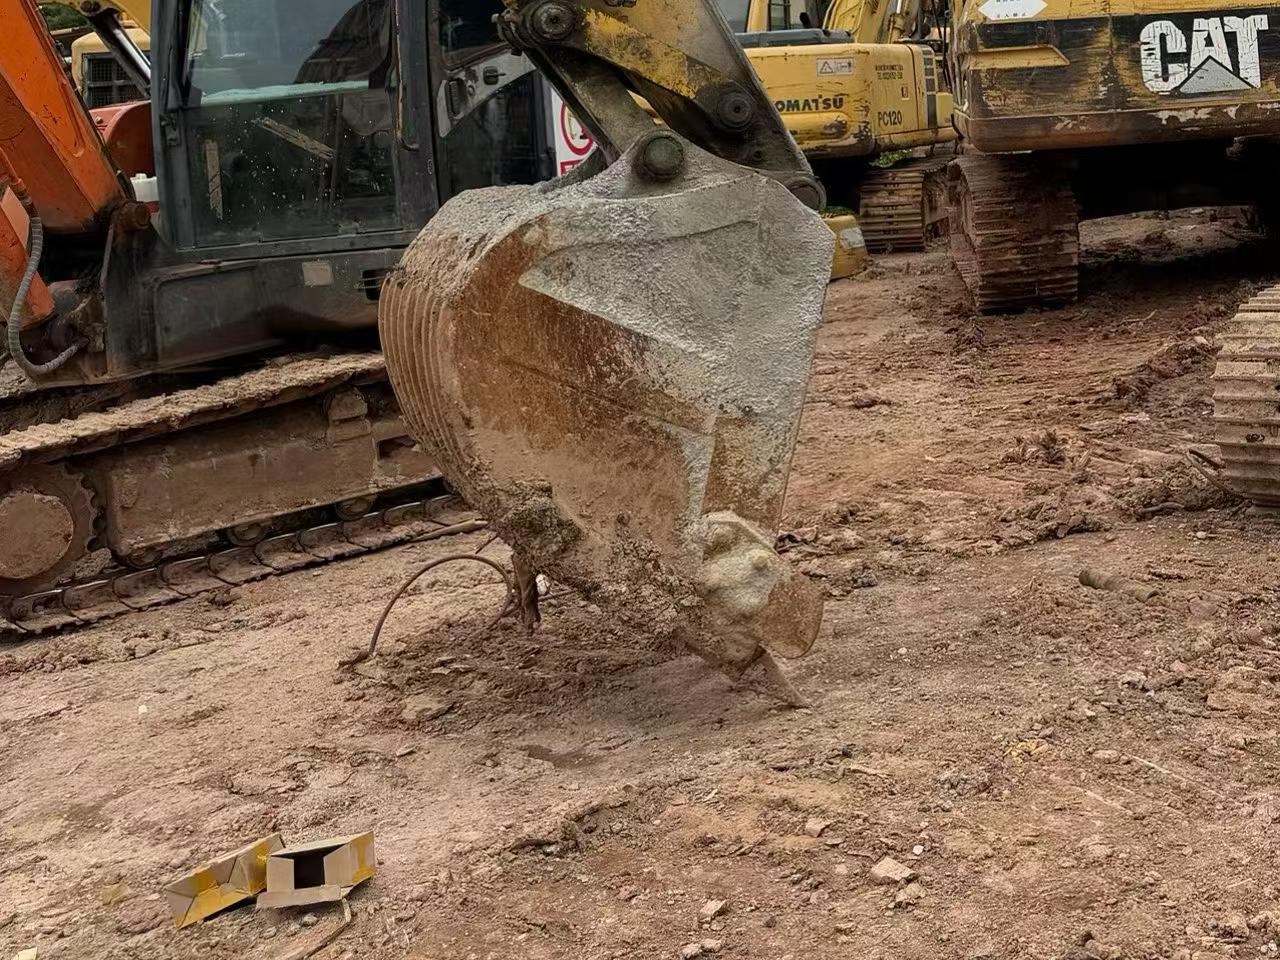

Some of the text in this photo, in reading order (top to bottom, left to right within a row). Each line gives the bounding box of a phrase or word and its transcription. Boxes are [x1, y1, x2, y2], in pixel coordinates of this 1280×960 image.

[1140, 14, 1269, 93] CAT
[775, 94, 844, 113] OMATSU
[877, 109, 902, 127] PC120
